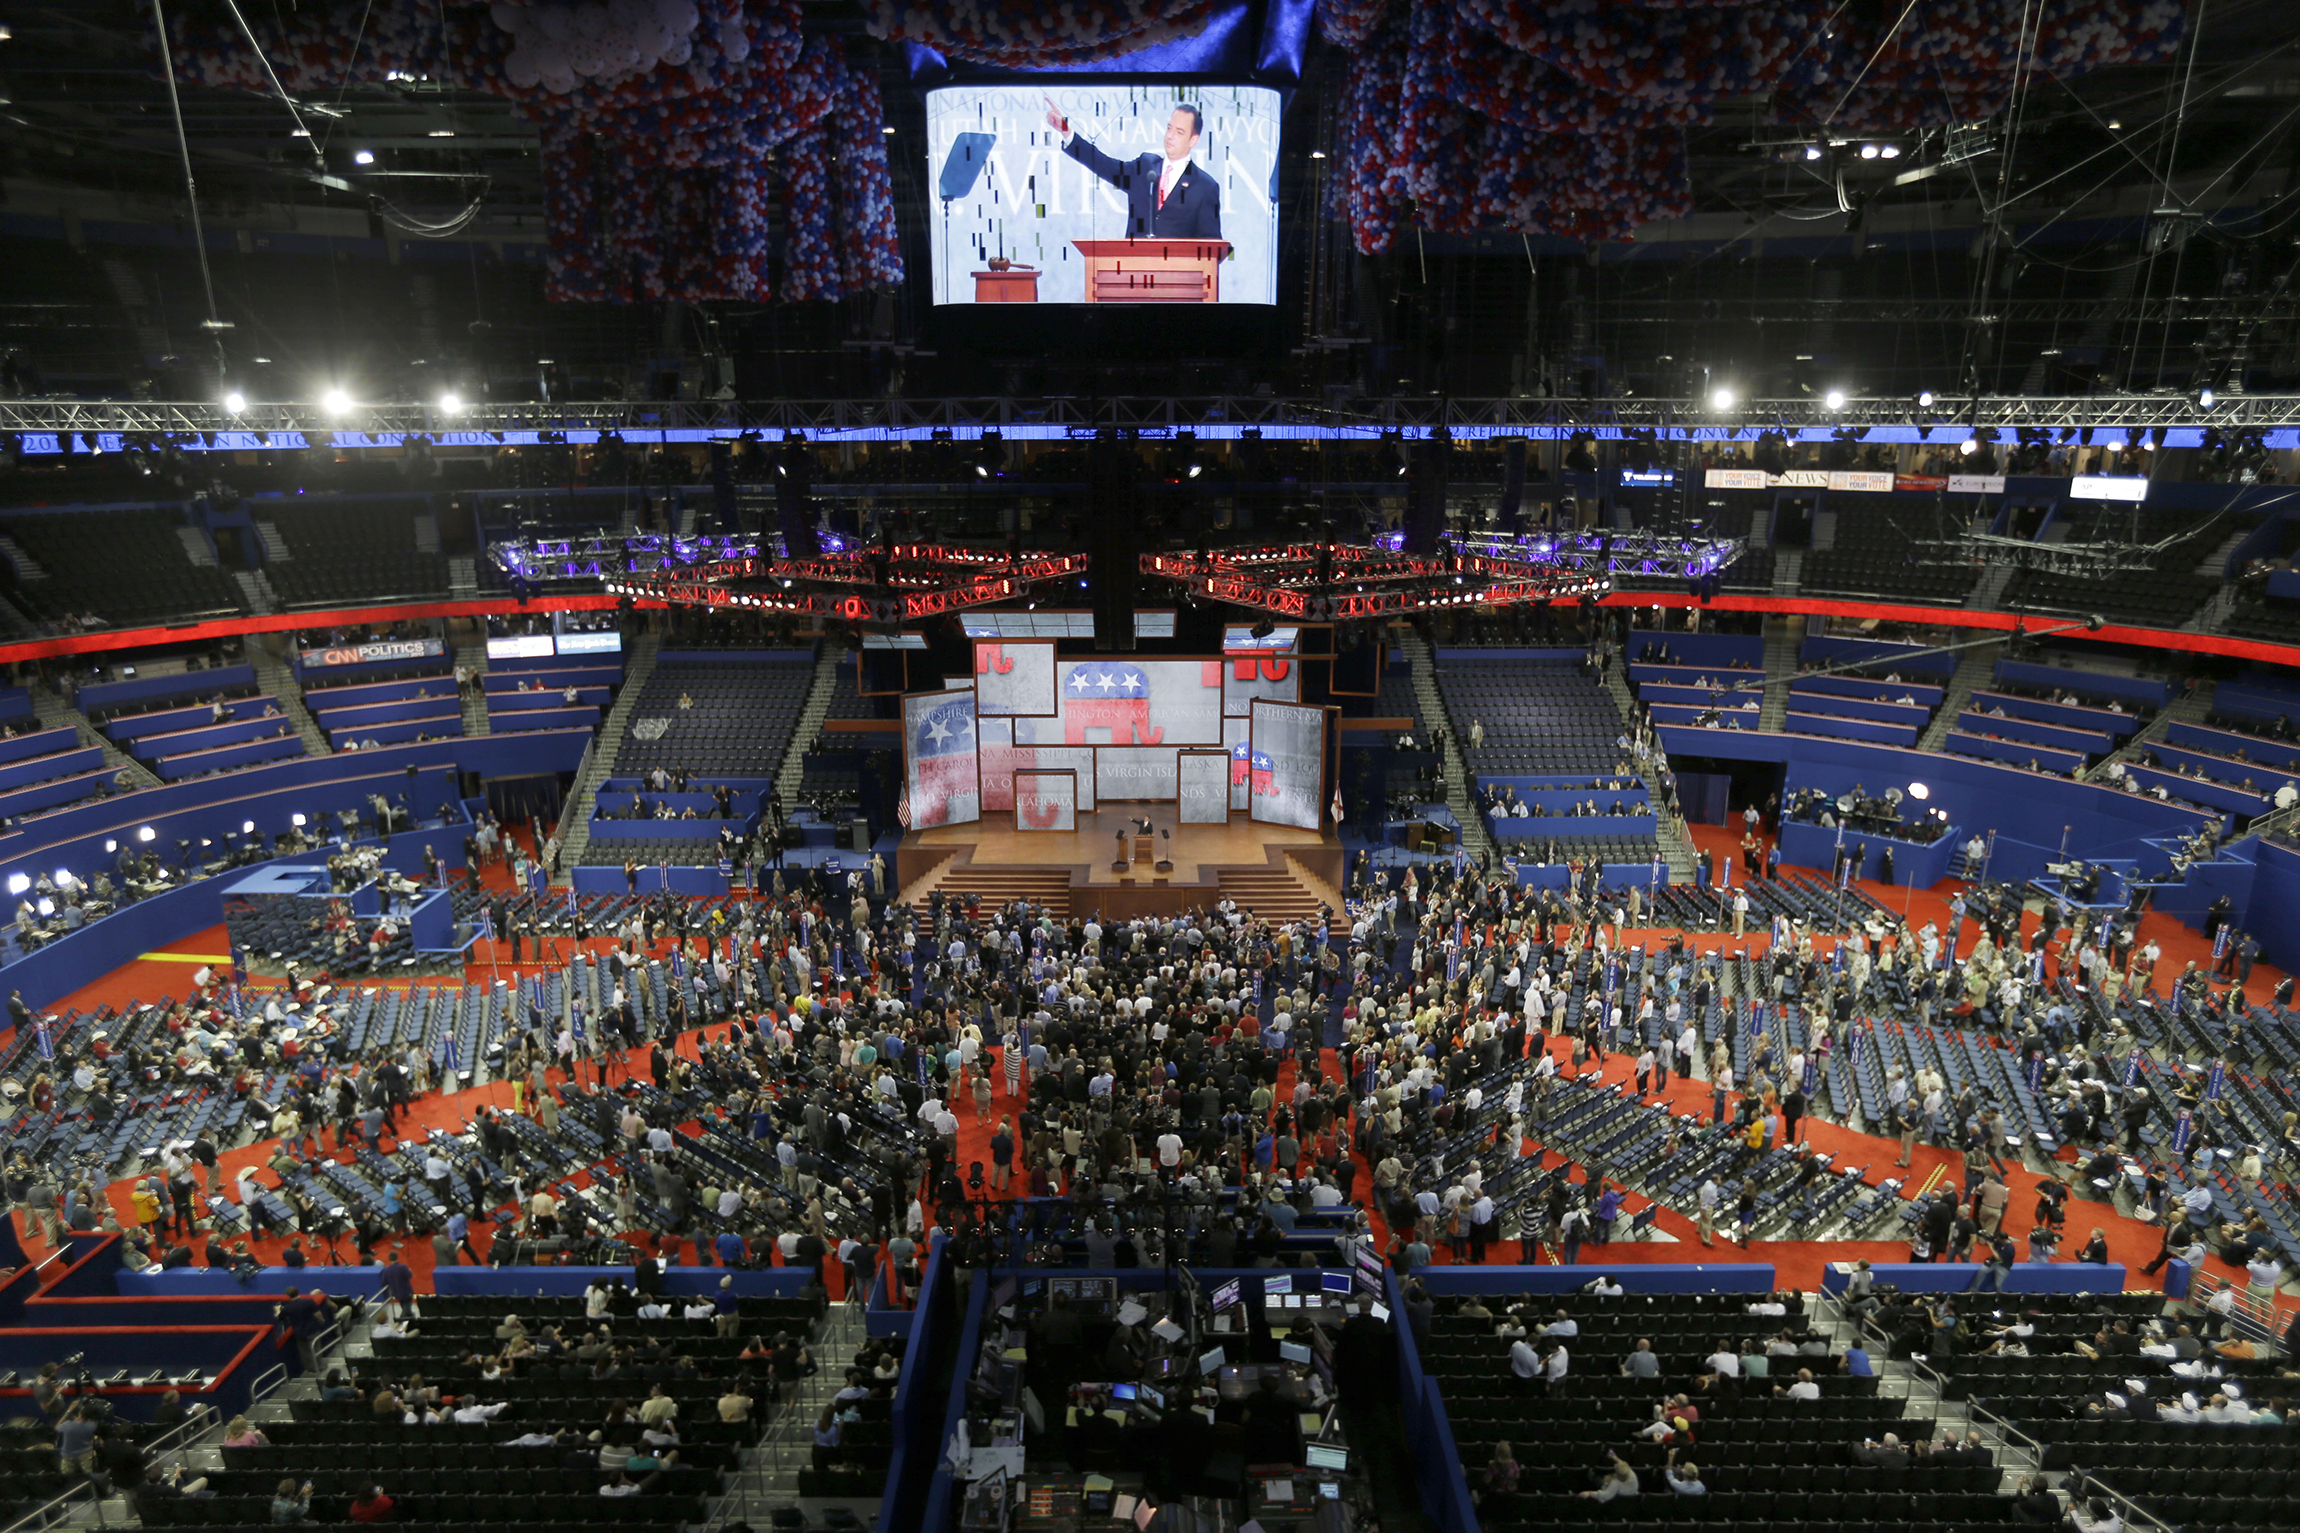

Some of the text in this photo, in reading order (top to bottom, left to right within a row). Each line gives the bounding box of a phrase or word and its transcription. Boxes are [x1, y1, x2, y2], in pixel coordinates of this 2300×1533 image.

[1039, 116, 1172, 145] MONTAN
[988, 149, 1271, 216] VIRN
[359, 433, 493, 447] CONTION
[1725, 472, 1761, 480] YOUR VOICE
[1782, 473, 1828, 485] NEWS
[1725, 479, 1761, 487] YOUR VOTE
[1849, 481, 1868, 489] YOUR
[1868, 482, 1888, 490] VOTE
[325, 642, 425, 665] CNN POLITICS
[1129, 709, 1190, 719] AMERICAN
[1002, 749, 1072, 759] MISSISSIPPI
[1106, 767, 1153, 778] VIRGIN
[2125, 1057, 2138, 1086] MAINE
